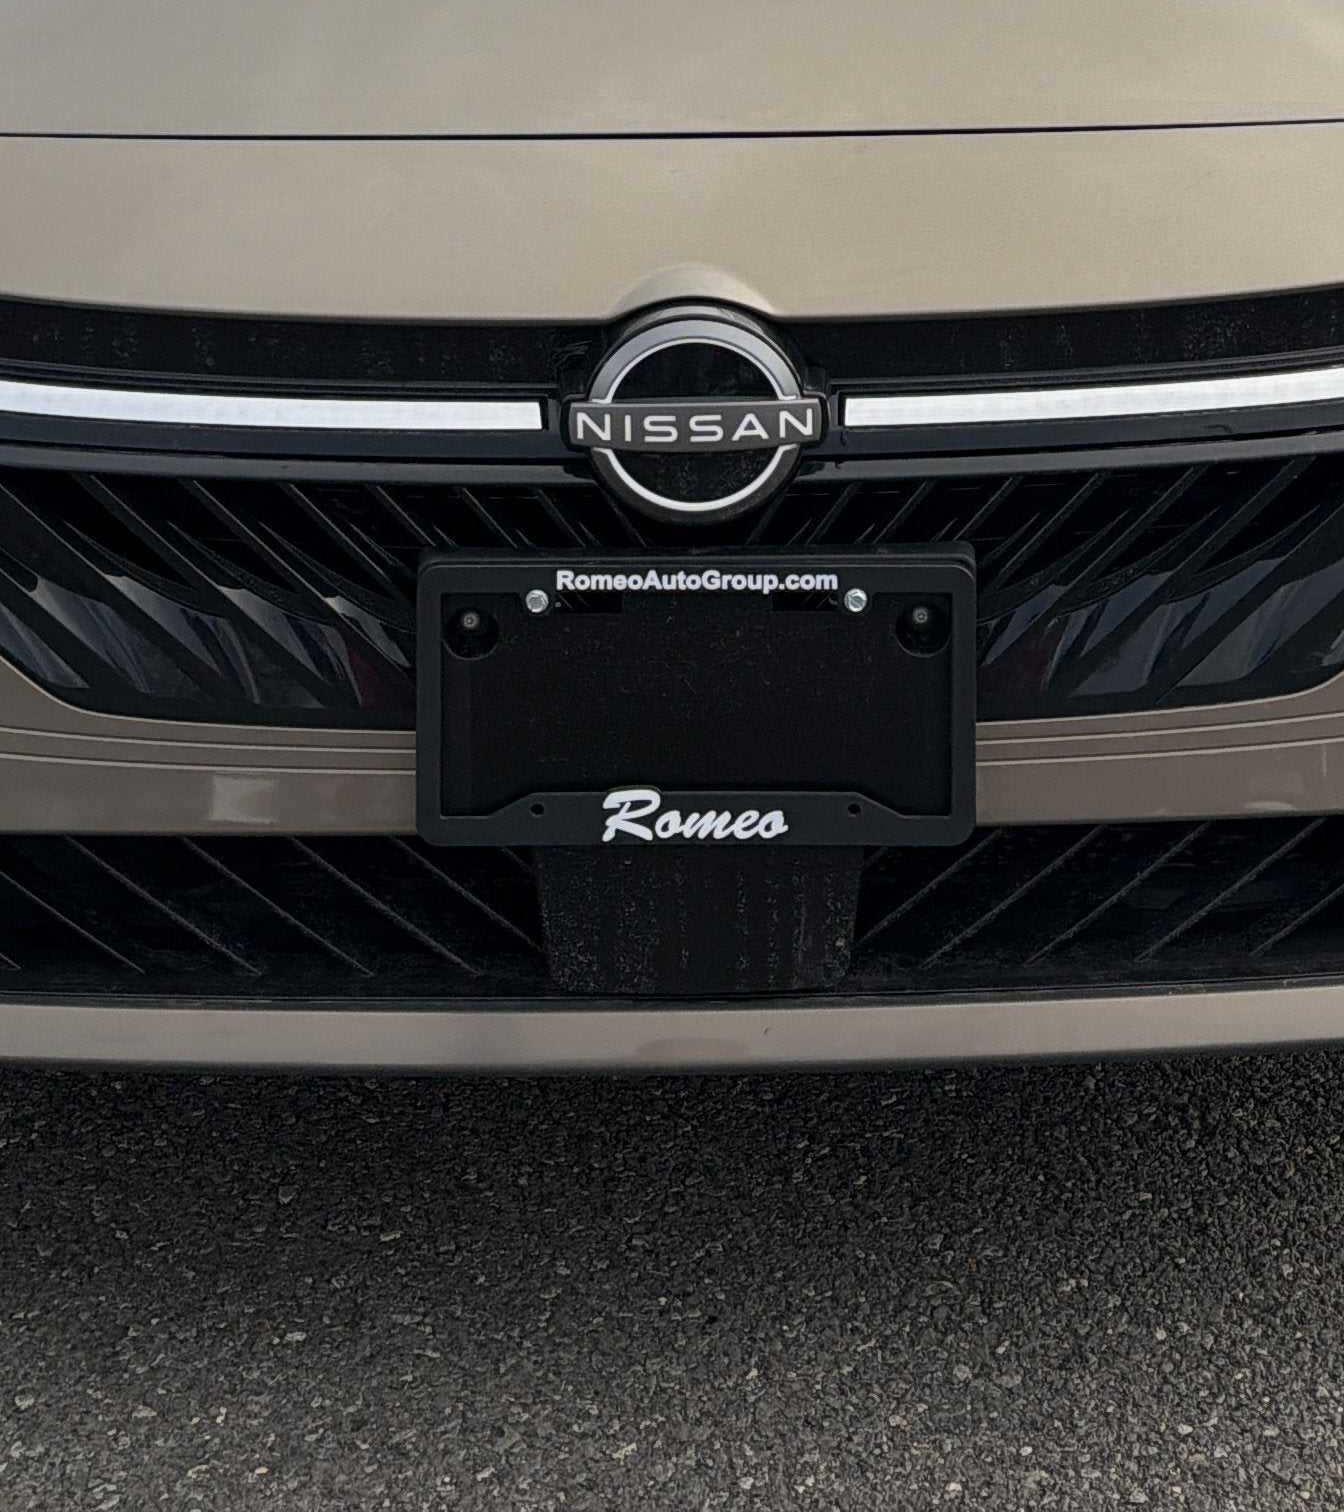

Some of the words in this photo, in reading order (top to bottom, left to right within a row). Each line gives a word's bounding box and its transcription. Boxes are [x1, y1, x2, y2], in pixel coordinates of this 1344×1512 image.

[576, 407, 814, 443] NISSAN
[556, 569, 838, 594] RomeoAutoGroup.com
[601, 788, 789, 843] Romeo
